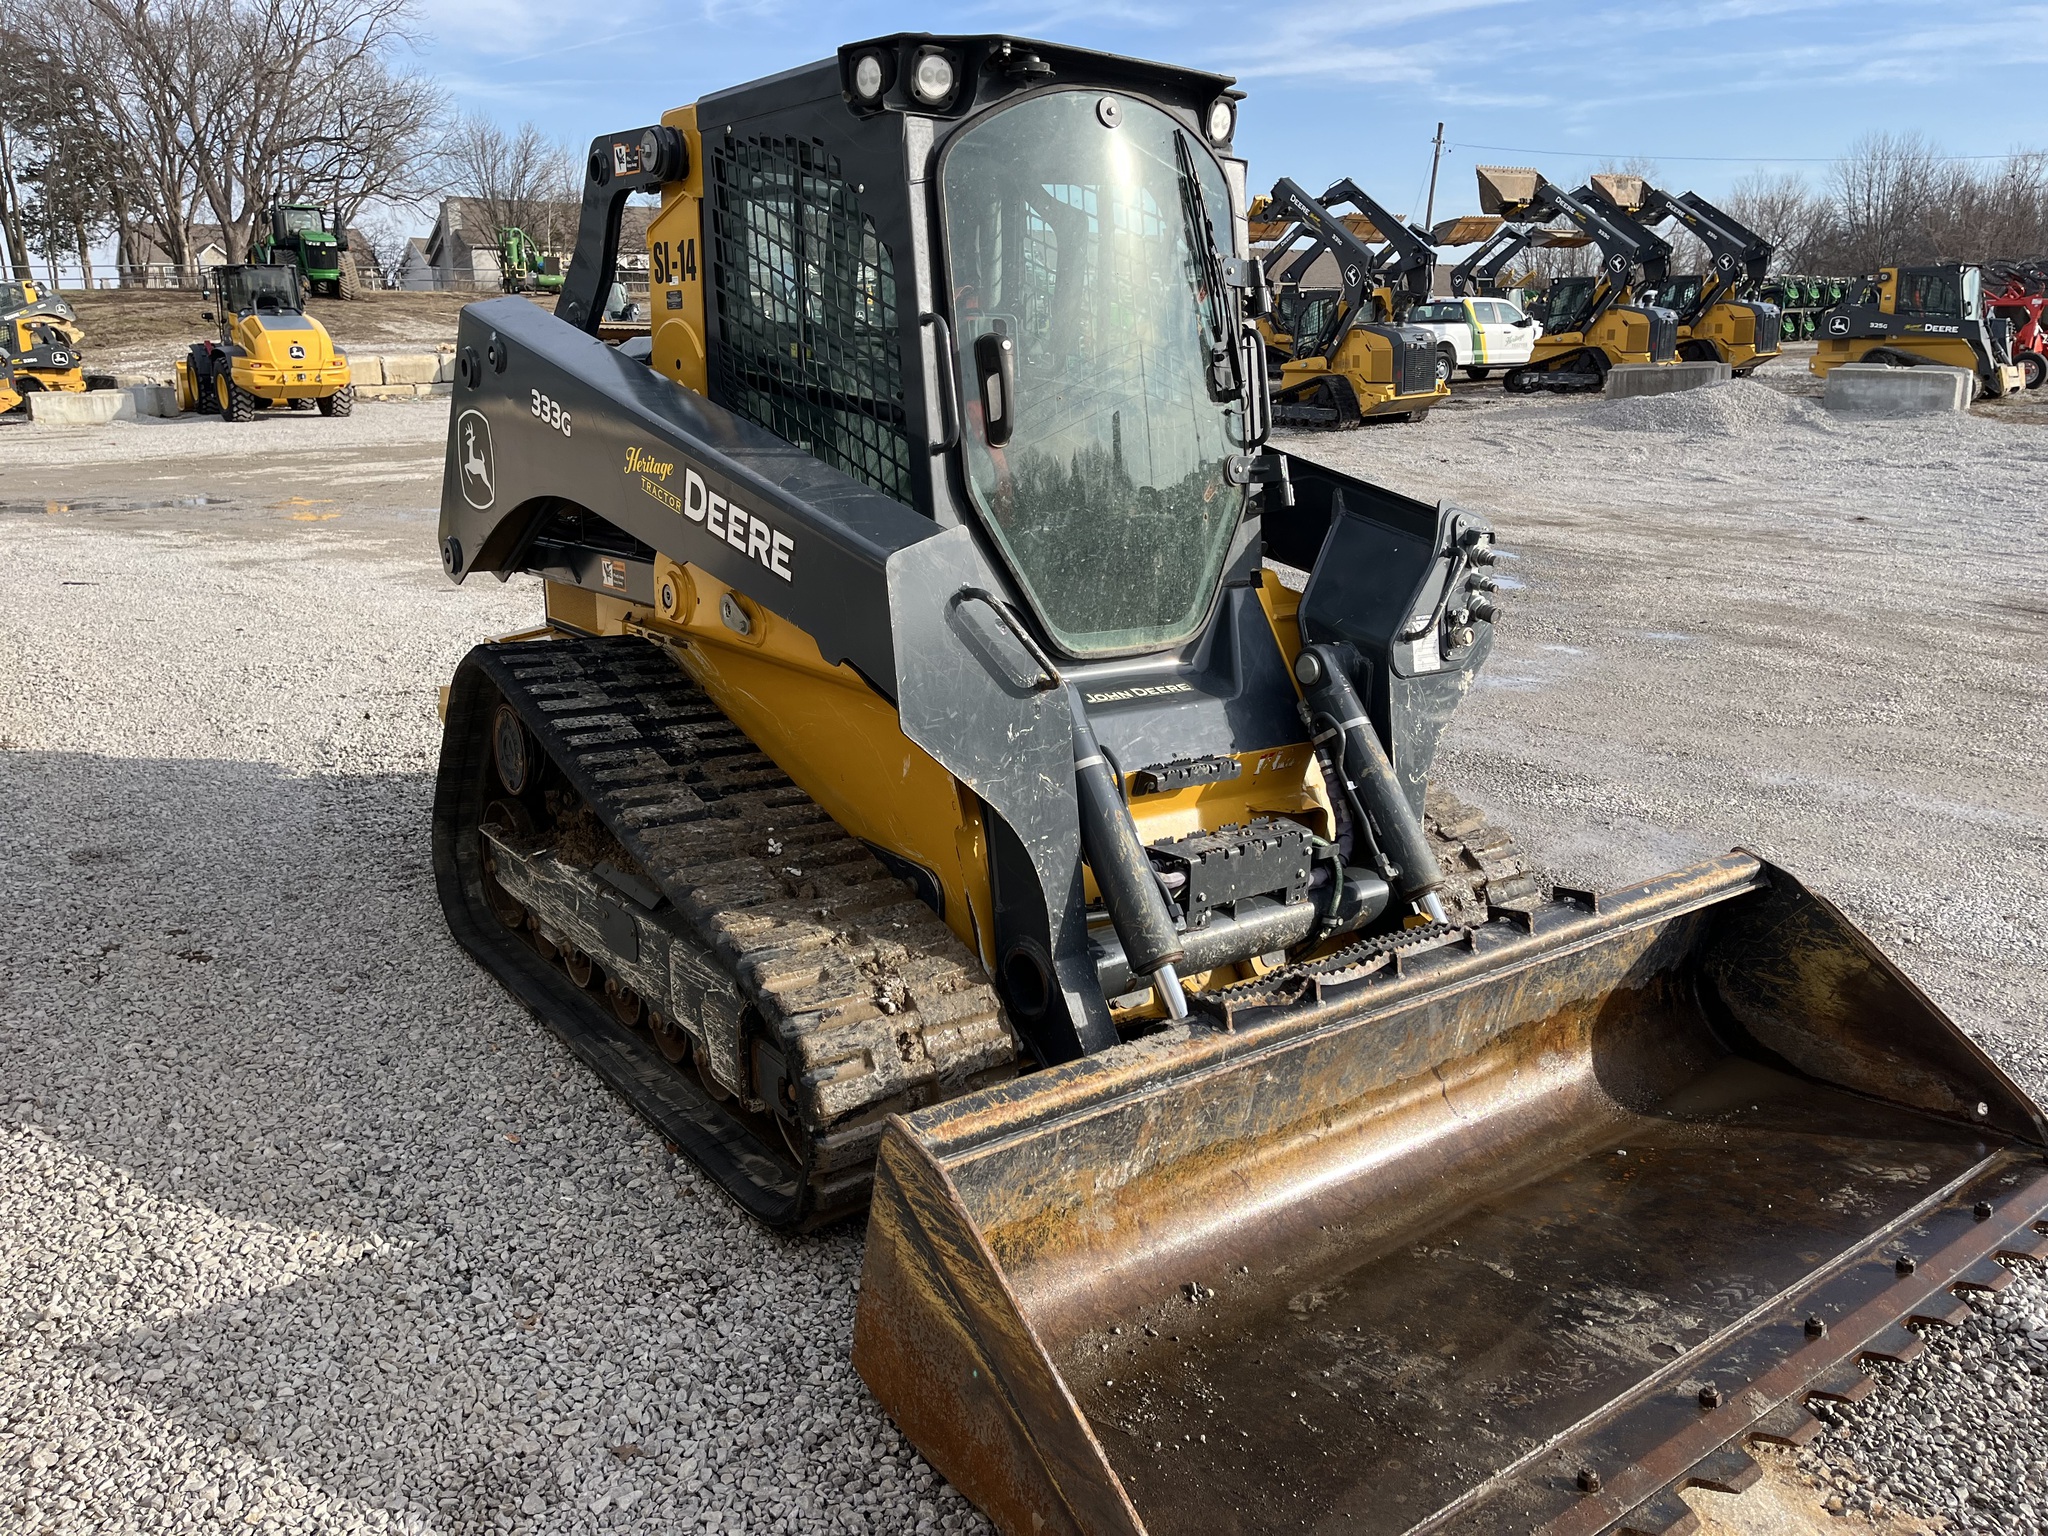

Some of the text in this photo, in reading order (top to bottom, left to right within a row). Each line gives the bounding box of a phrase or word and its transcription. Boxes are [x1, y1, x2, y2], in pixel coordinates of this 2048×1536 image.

[1290, 194, 1311, 216] DEERE
[1555, 196, 1577, 214] DEERE
[1665, 201, 1686, 218] DEERE
[653, 238, 696, 284] SL-14
[1924, 323, 1959, 333] DEERE
[531, 388, 571, 437] 333G
[624, 446, 674, 481] Heritage
[641, 477, 682, 512] TRACTOR
[684, 467, 795, 582] DEERE
[1086, 683, 1193, 703] JOHN DEERE
